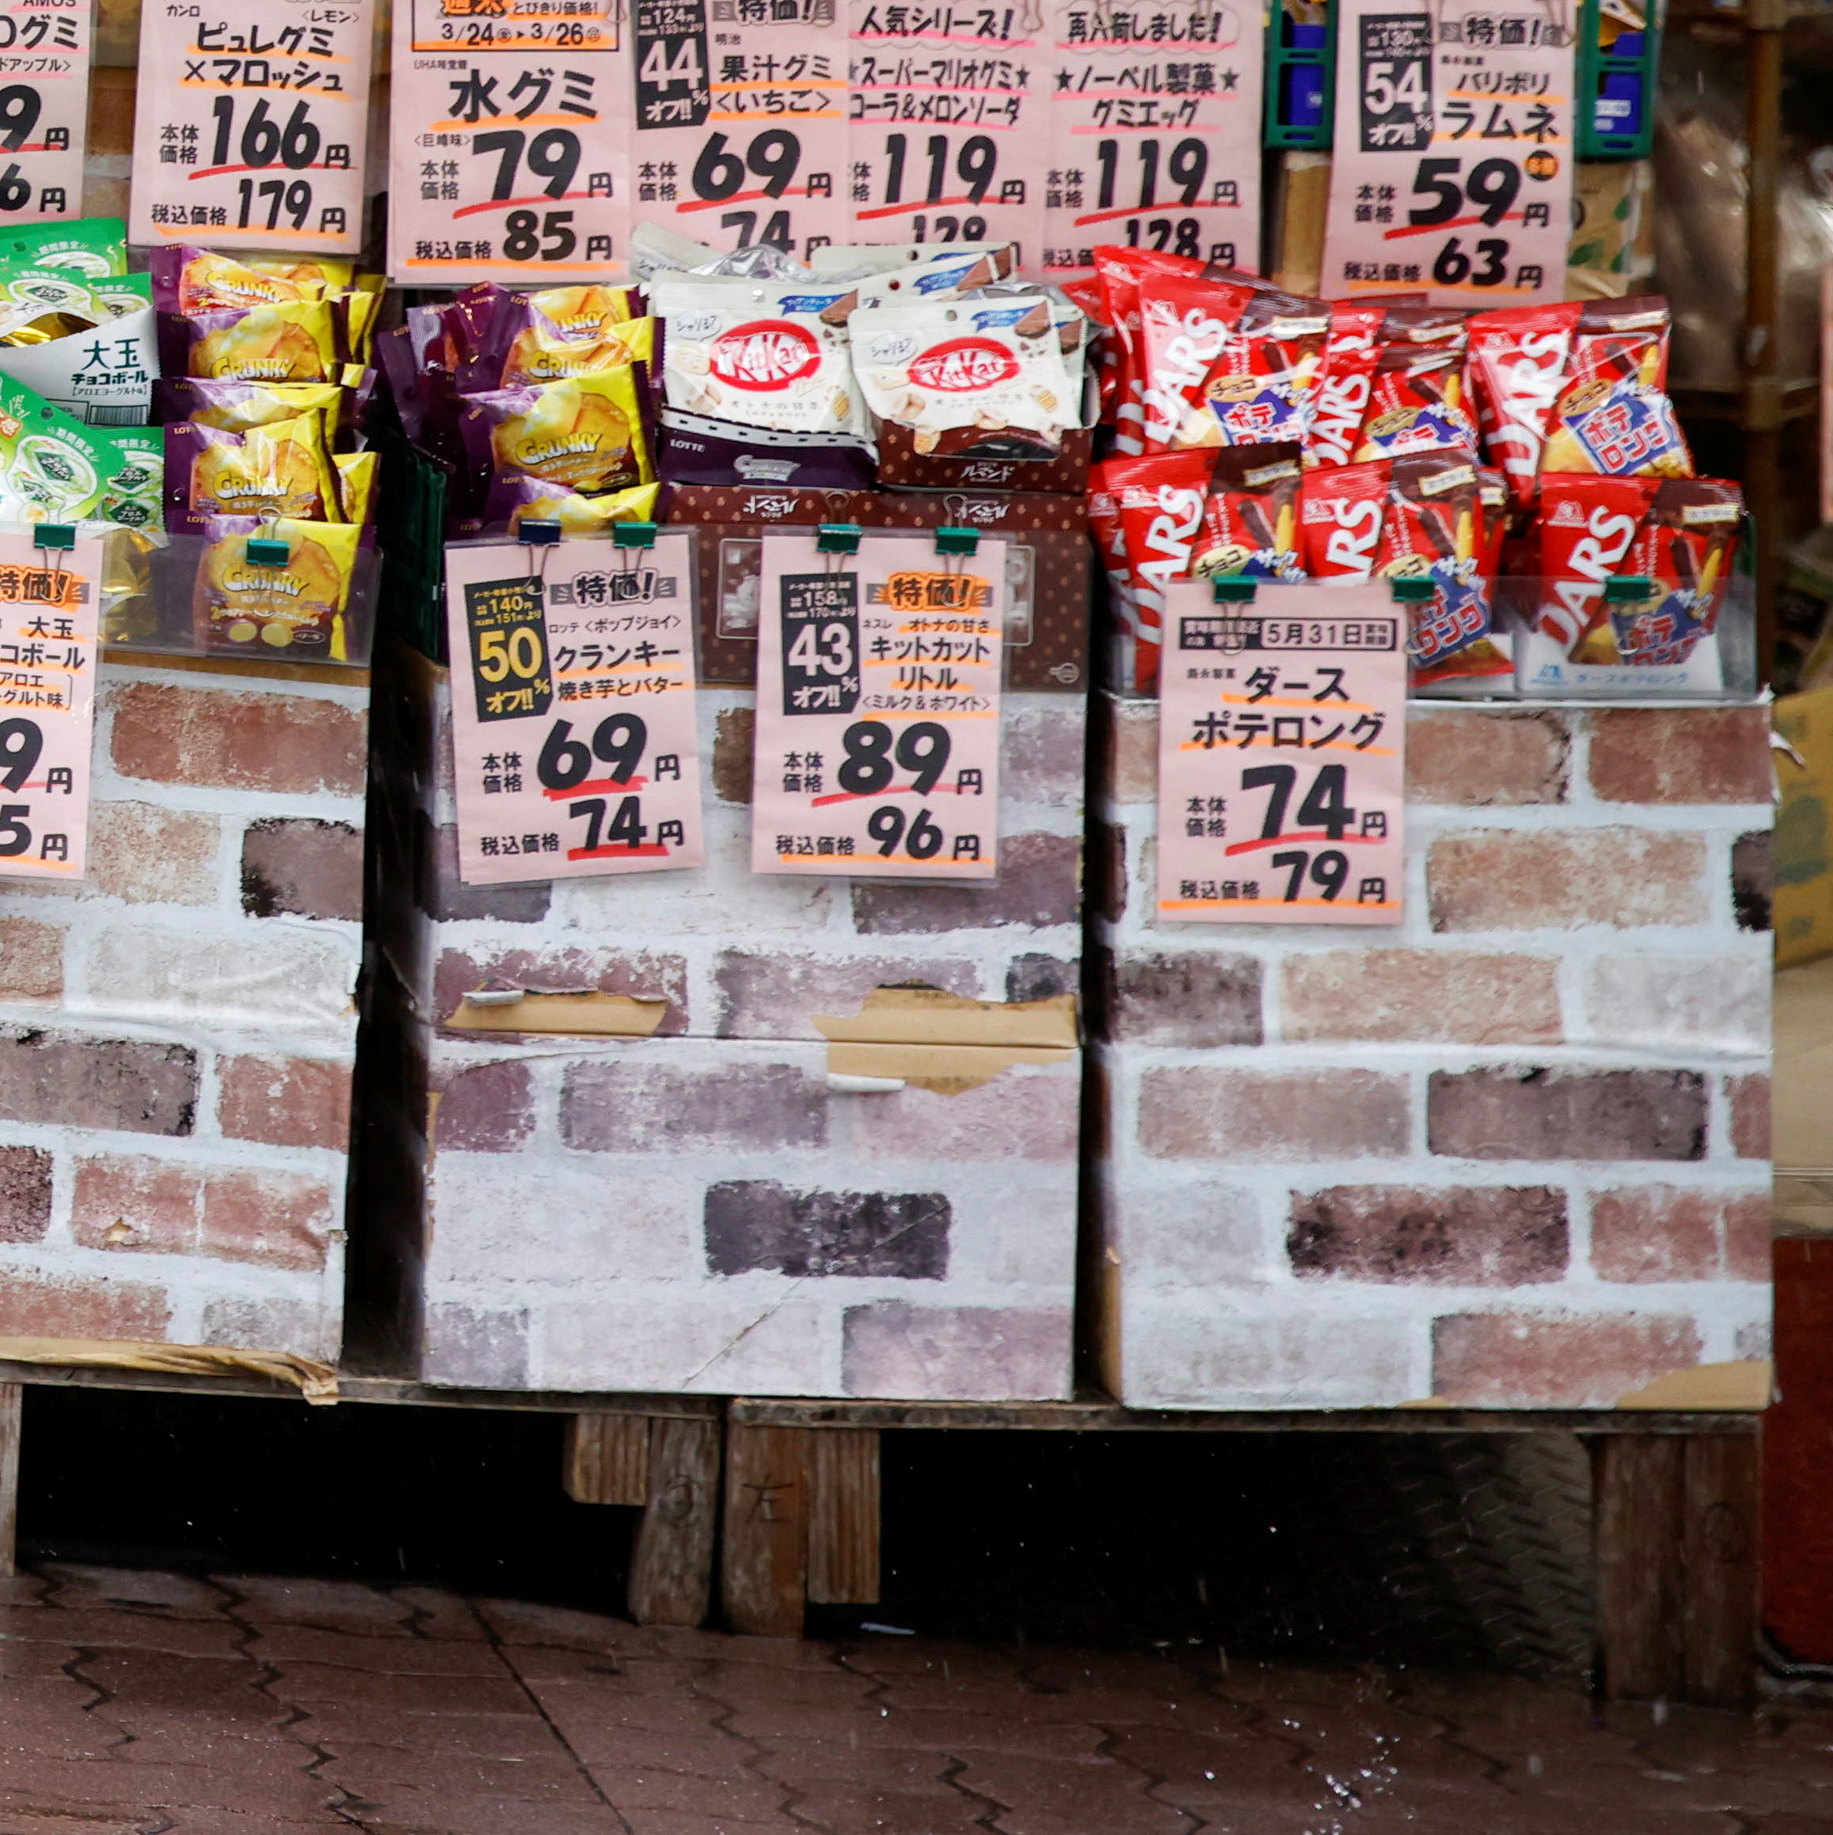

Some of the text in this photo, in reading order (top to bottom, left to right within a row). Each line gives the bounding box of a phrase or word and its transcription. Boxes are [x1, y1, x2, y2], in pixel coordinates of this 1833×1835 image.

[197, 23, 334, 54] ピュレグミ
[720, 54, 832, 83] 果汁グミ
[448, 68, 599, 123] 水グミ
[1092, 99, 1199, 129] グミエッグ
[1440, 103, 1561, 140] ラムネ
[82, 338, 142, 370] 大玉
[71, 367, 149, 387] チョコボール
[670, 439, 705, 453] LOTTE
[28, 617, 74, 640] 大玉
[908, 618, 990, 635] オトナの甘さ
[1267, 624, 1362, 645] 5月31日
[478, 628, 543, 682] 50
[553, 640, 681, 668] クランキー
[788, 624, 854, 676] 43
[871, 637, 991, 663] キットカット
[0, 671, 43, 688] アロエ
[557, 676, 685, 702] 焼き芋とバター
[898, 667, 959, 691] リトル
[1245, 666, 1350, 703] ダース
[1192, 712, 1386, 750] ポテロング
